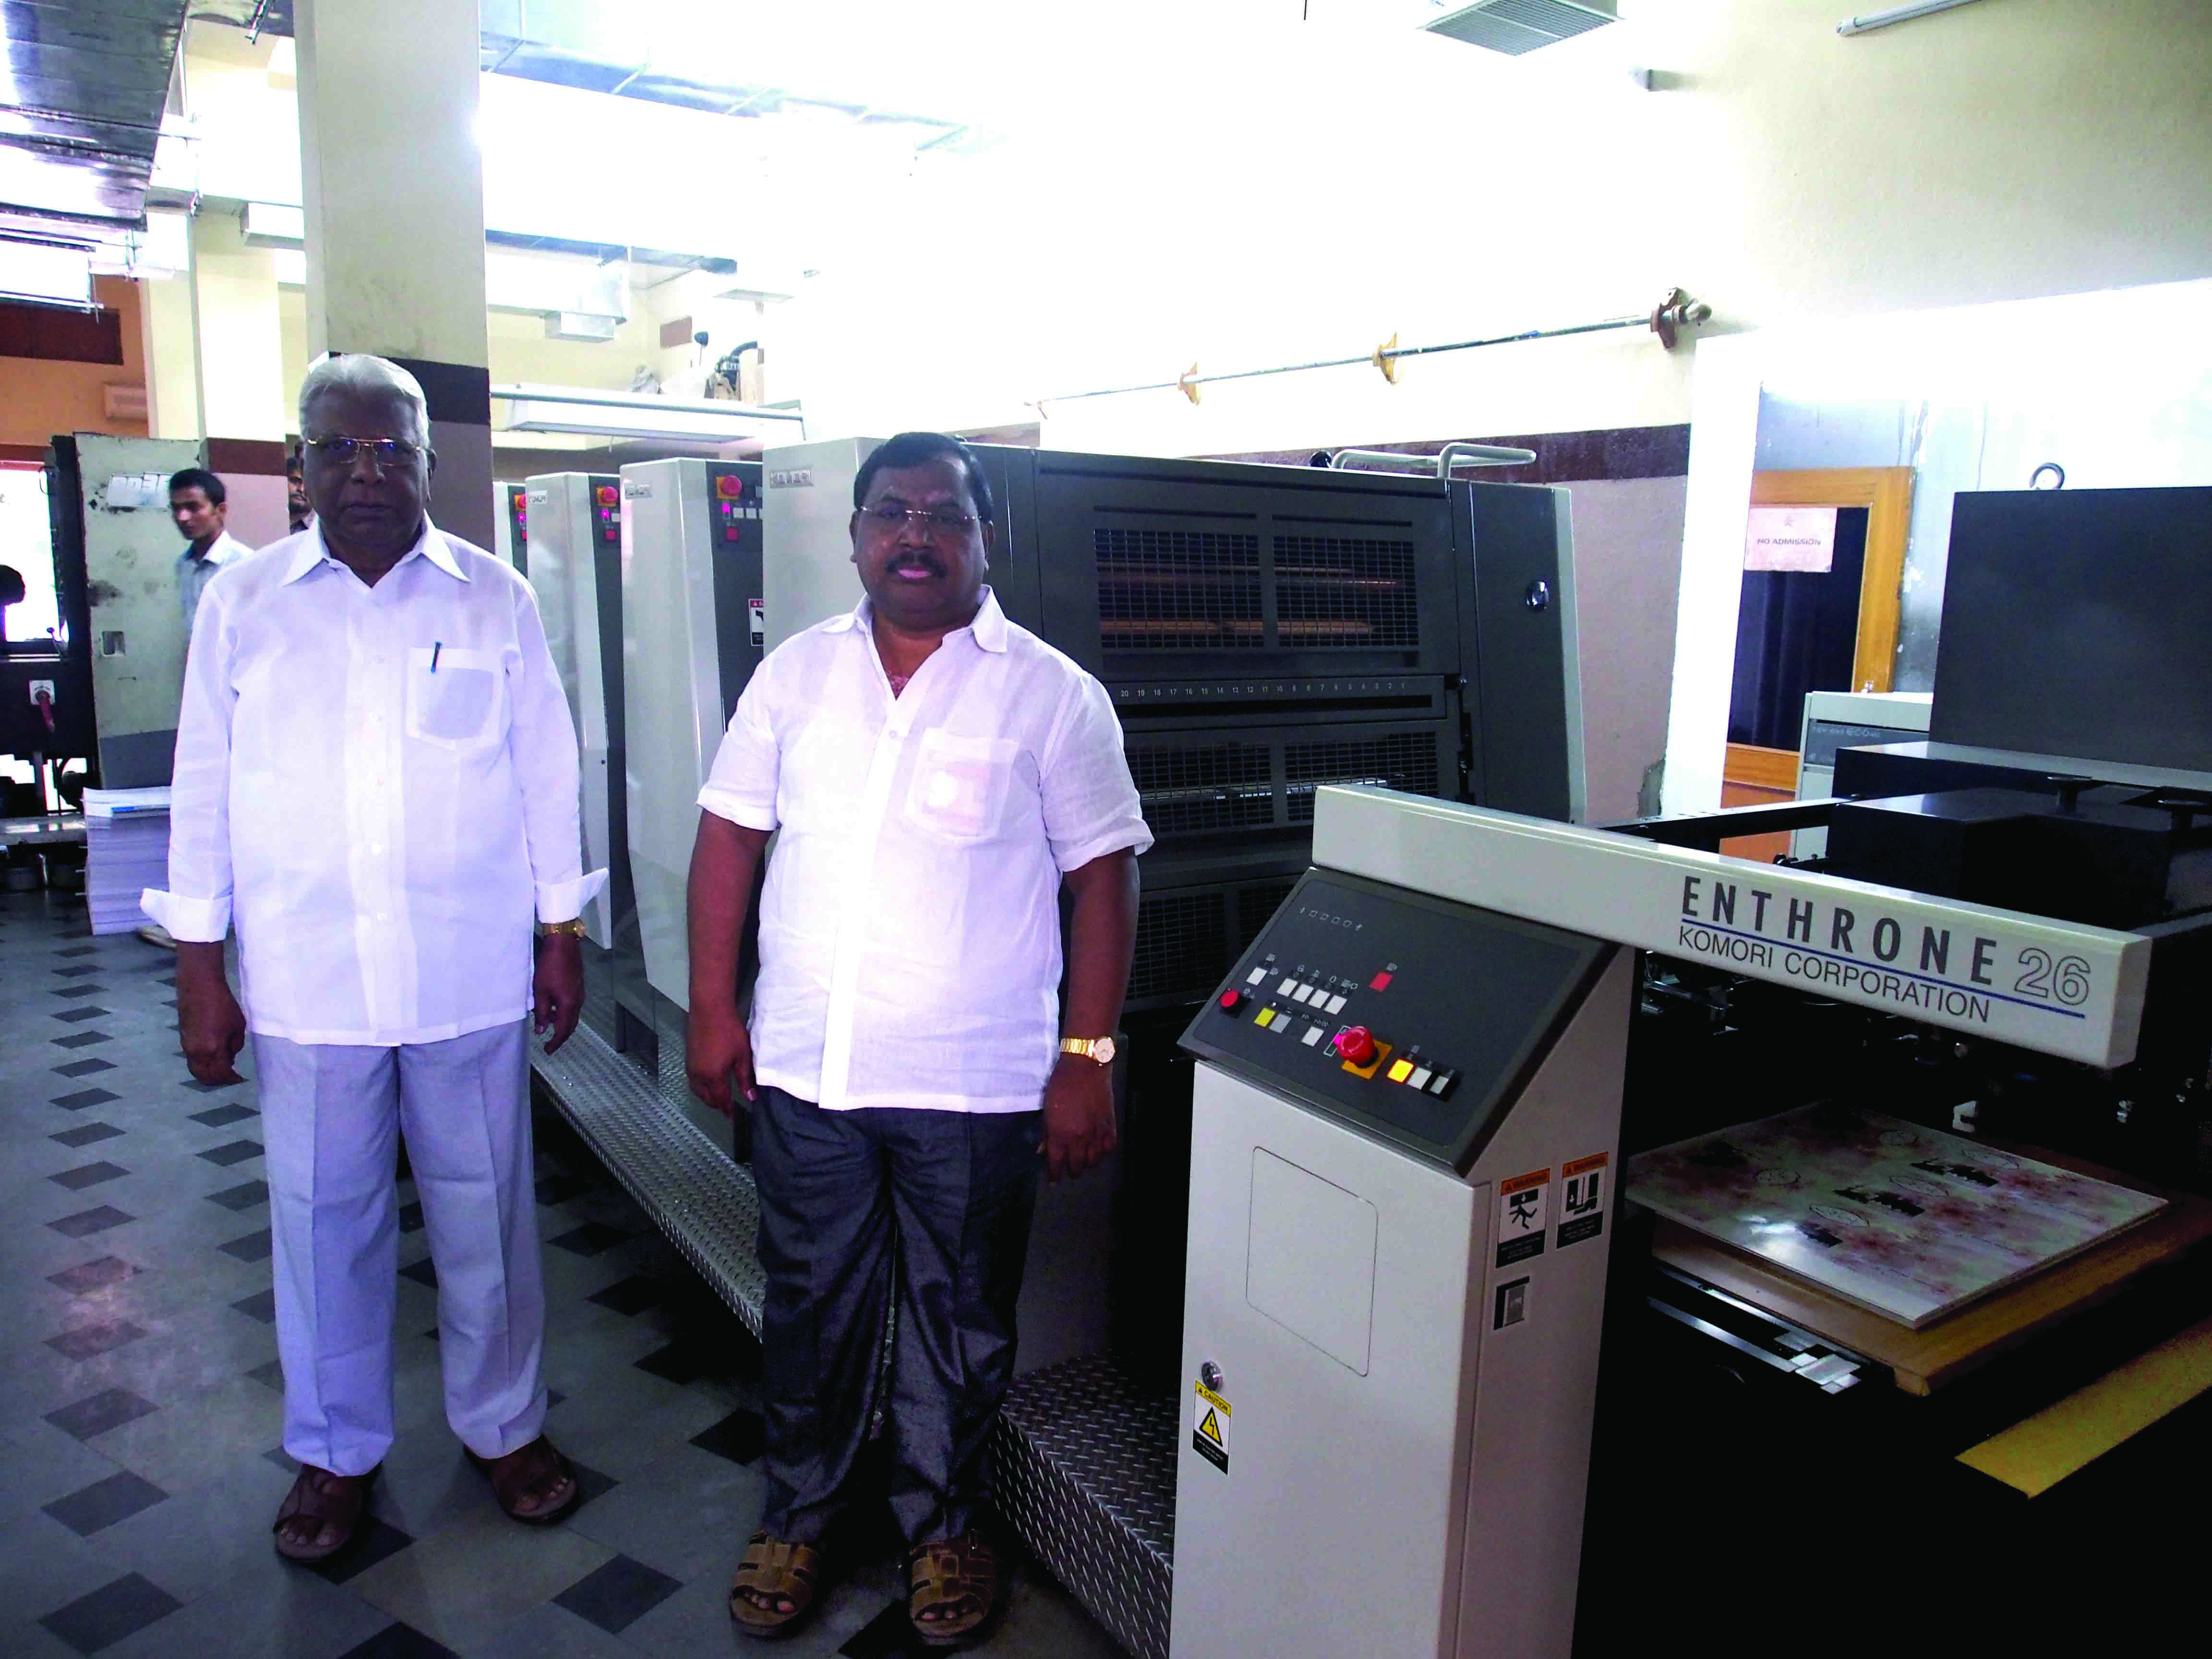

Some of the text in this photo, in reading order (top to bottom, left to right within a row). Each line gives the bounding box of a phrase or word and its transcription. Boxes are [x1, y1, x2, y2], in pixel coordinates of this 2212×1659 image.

[1773, 538, 1821, 546] ADMISSION
[1682, 875, 2091, 1006] ENTHRONE 26
[1678, 926, 1990, 1023] KOMORI CORPORATION
[1204, 1390, 1228, 1411] CAUTION
